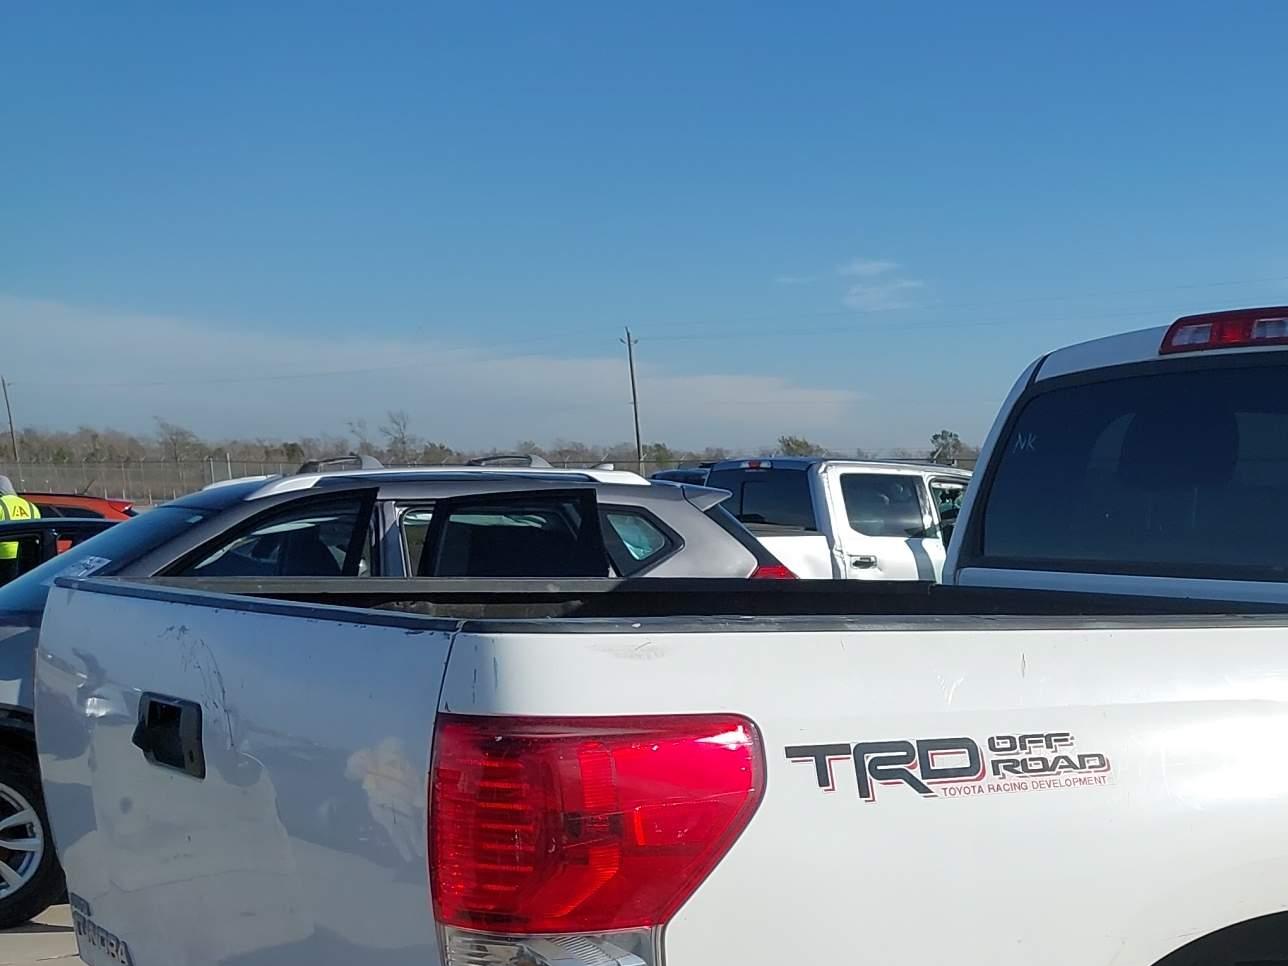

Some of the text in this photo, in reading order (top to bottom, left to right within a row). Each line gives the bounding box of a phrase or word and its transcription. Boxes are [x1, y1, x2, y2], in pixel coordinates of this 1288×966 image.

[988, 732, 1074, 755] OFF
[784, 736, 986, 803] TRD
[990, 753, 1111, 779] ROAD
[940, 775, 1108, 797] TOYOTA RACING DEVELOPMENT
